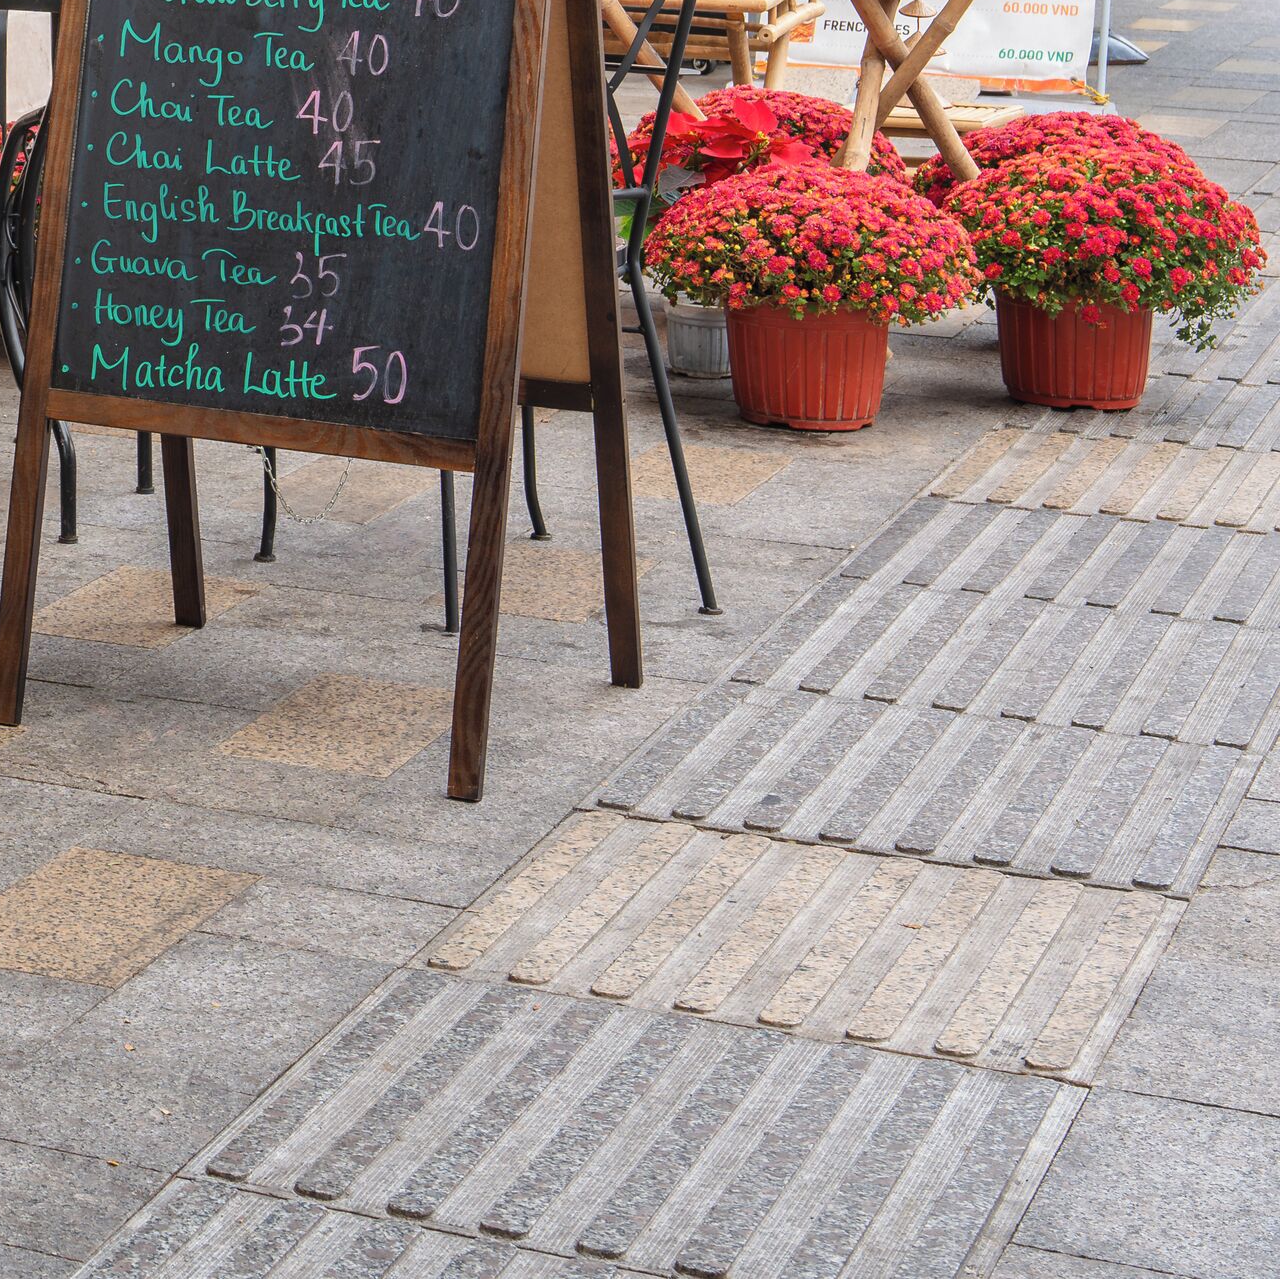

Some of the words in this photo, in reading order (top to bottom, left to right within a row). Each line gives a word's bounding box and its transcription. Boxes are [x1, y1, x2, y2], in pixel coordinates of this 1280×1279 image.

[1002, 0, 1049, 16] 60.000
[1051, 3, 1080, 17] VND
[119, 18, 244, 86] Mango
[253, 31, 315, 72] Tea
[336, 29, 390, 77] 40
[998, 47, 1044, 62] 60.000
[1047, 49, 1075, 64] VND
[207, 94, 274, 129] Tea
[295, 89, 354, 135] 40
[106, 131, 183, 171] Chai
[205, 139, 301, 181] Latte
[317, 138, 381, 185] 45
[103, 181, 220, 243] English
[227, 189, 366, 257] Breakfast
[367, 203, 421, 241] Tea
[423, 200, 480, 251] 40
[90, 238, 198, 281] Guava
[201, 248, 277, 285] Tea
[94, 287, 184, 346] Honey
[190, 298, 257, 334] Tea
[90, 342, 225, 393] Matcha
[243, 351, 337, 400] Latte
[352, 345, 407, 405] 50
